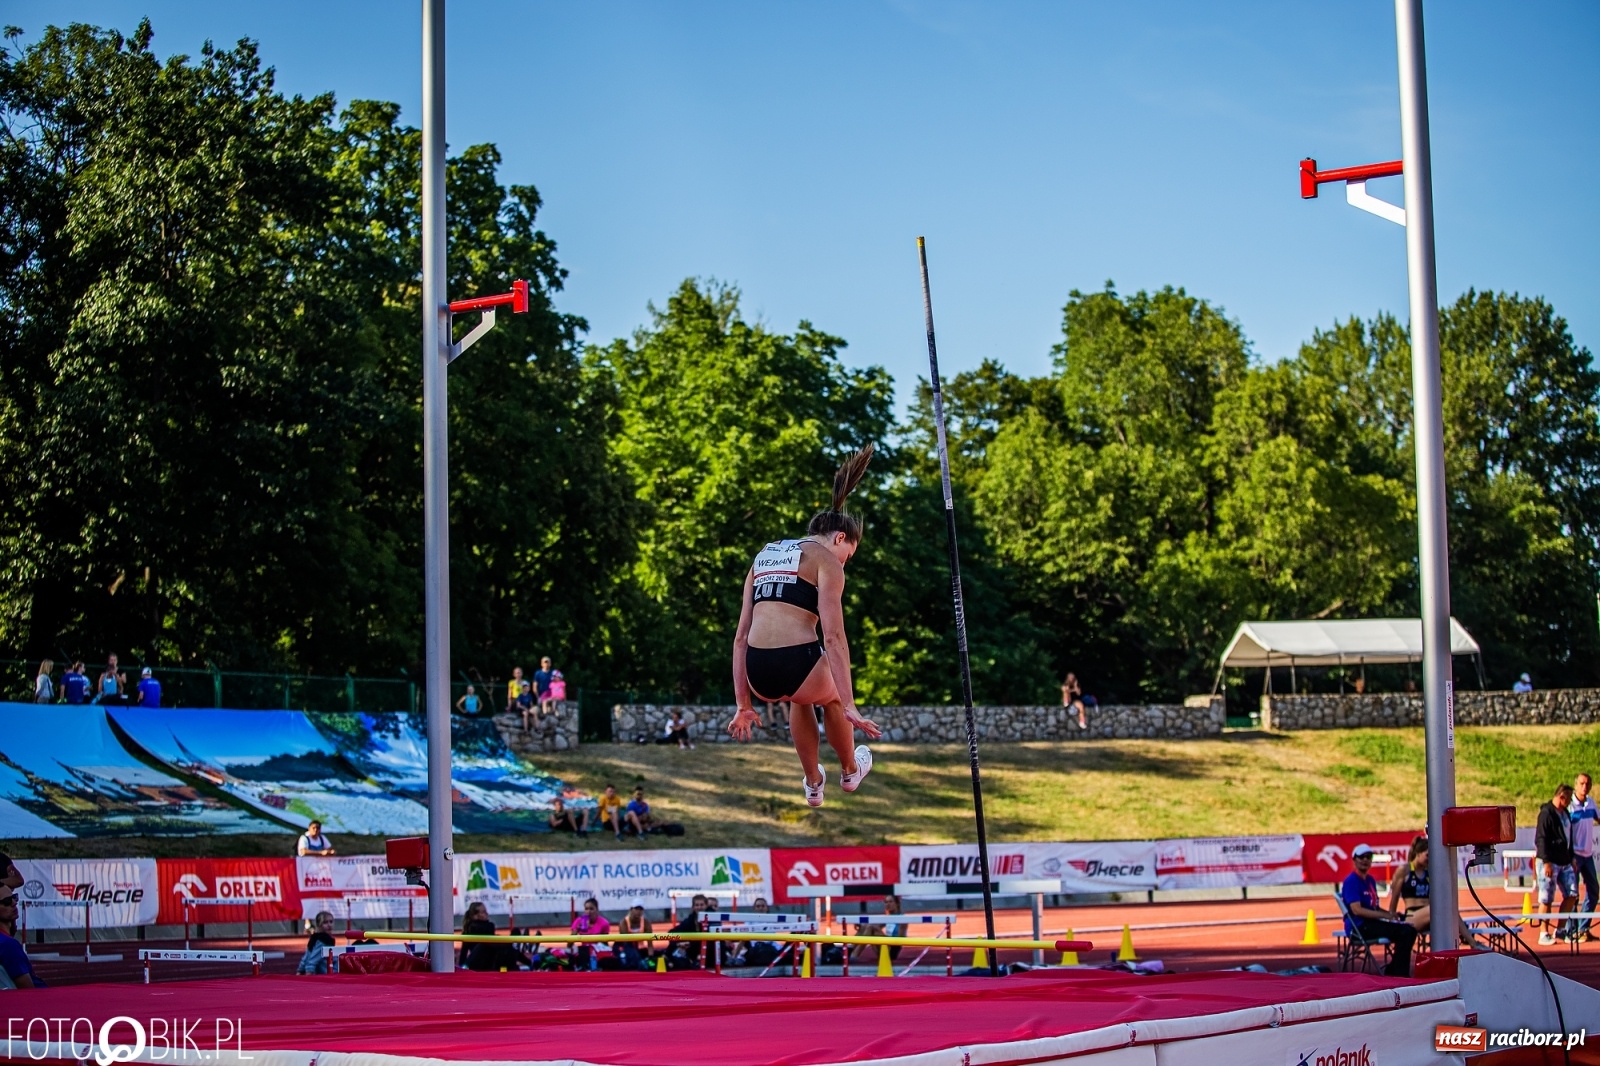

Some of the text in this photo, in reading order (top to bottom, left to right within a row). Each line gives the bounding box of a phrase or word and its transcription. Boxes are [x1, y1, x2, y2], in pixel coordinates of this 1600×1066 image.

[758, 556, 793, 567] WEJMAN
[535, 862, 699, 880] POWIAT RACIBORSKI
[830, 866, 878, 881] ORLEN
[219, 879, 277, 899] ORLEN
[600, 885, 664, 899] wspieramy,
